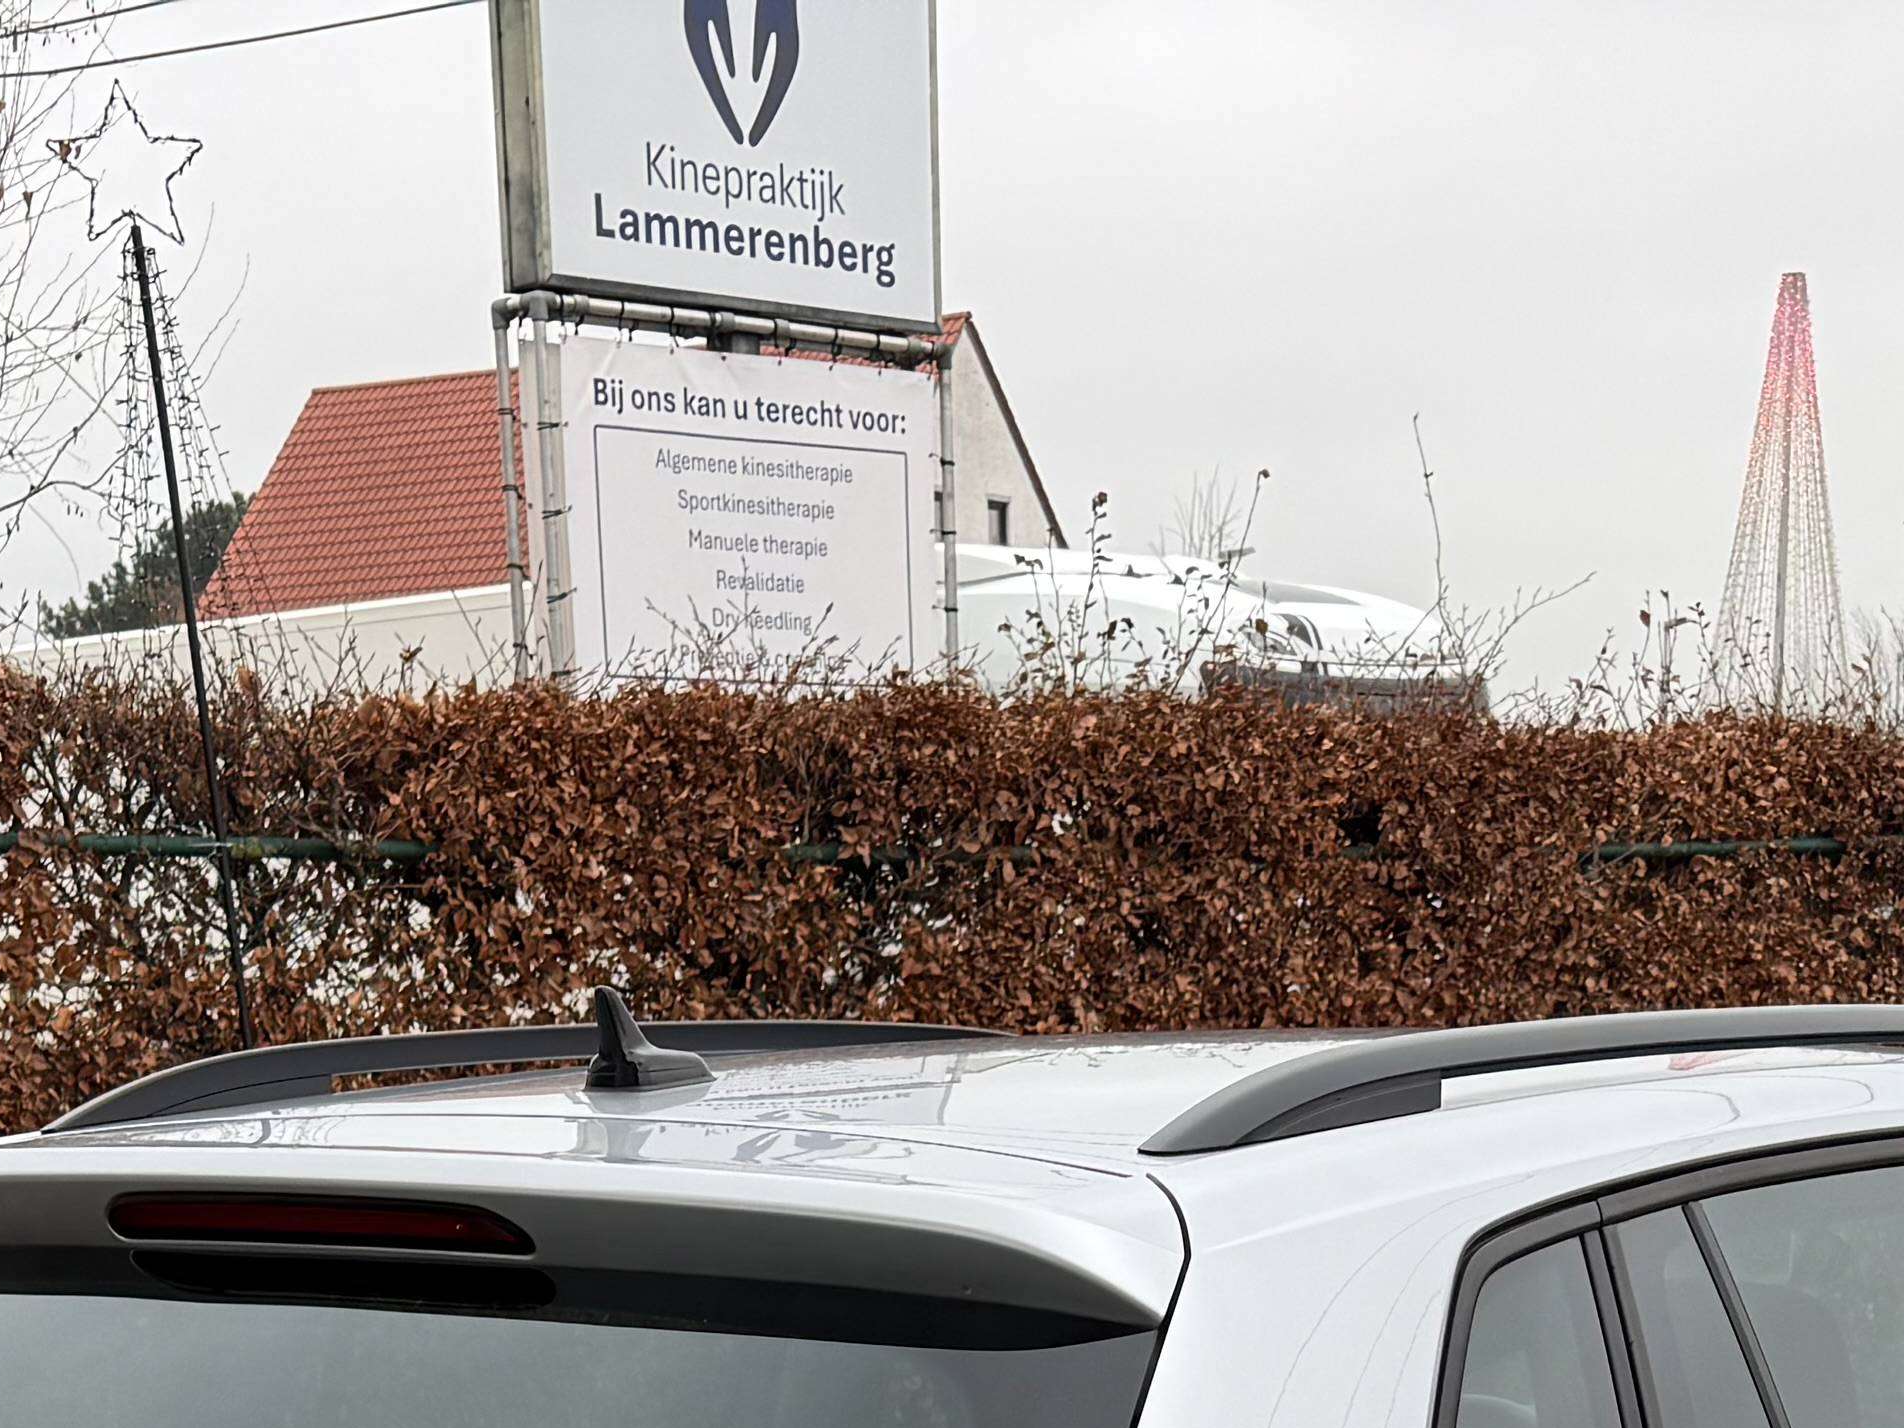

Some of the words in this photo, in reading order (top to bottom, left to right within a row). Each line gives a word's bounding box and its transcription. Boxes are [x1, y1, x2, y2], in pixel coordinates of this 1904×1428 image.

[645, 140, 846, 222] Kinepraktijk
[594, 192, 896, 288] Lammerenberg
[592, 377, 624, 415] Bij
[631, 387, 677, 414] ons
[683, 386, 726, 419] kan
[733, 398, 748, 421] u
[755, 396, 844, 431] terecht
[849, 409, 907, 435] voor:
[655, 447, 738, 477] Algemene
[741, 455, 854, 486] kinesitherapie
[677, 489, 835, 522] Sportkinesitherapie
[688, 529, 759, 555] Manuele
[762, 534, 828, 560] therapie
[716, 569, 805, 594] Revalidatie
[712, 607, 741, 631] Dry
